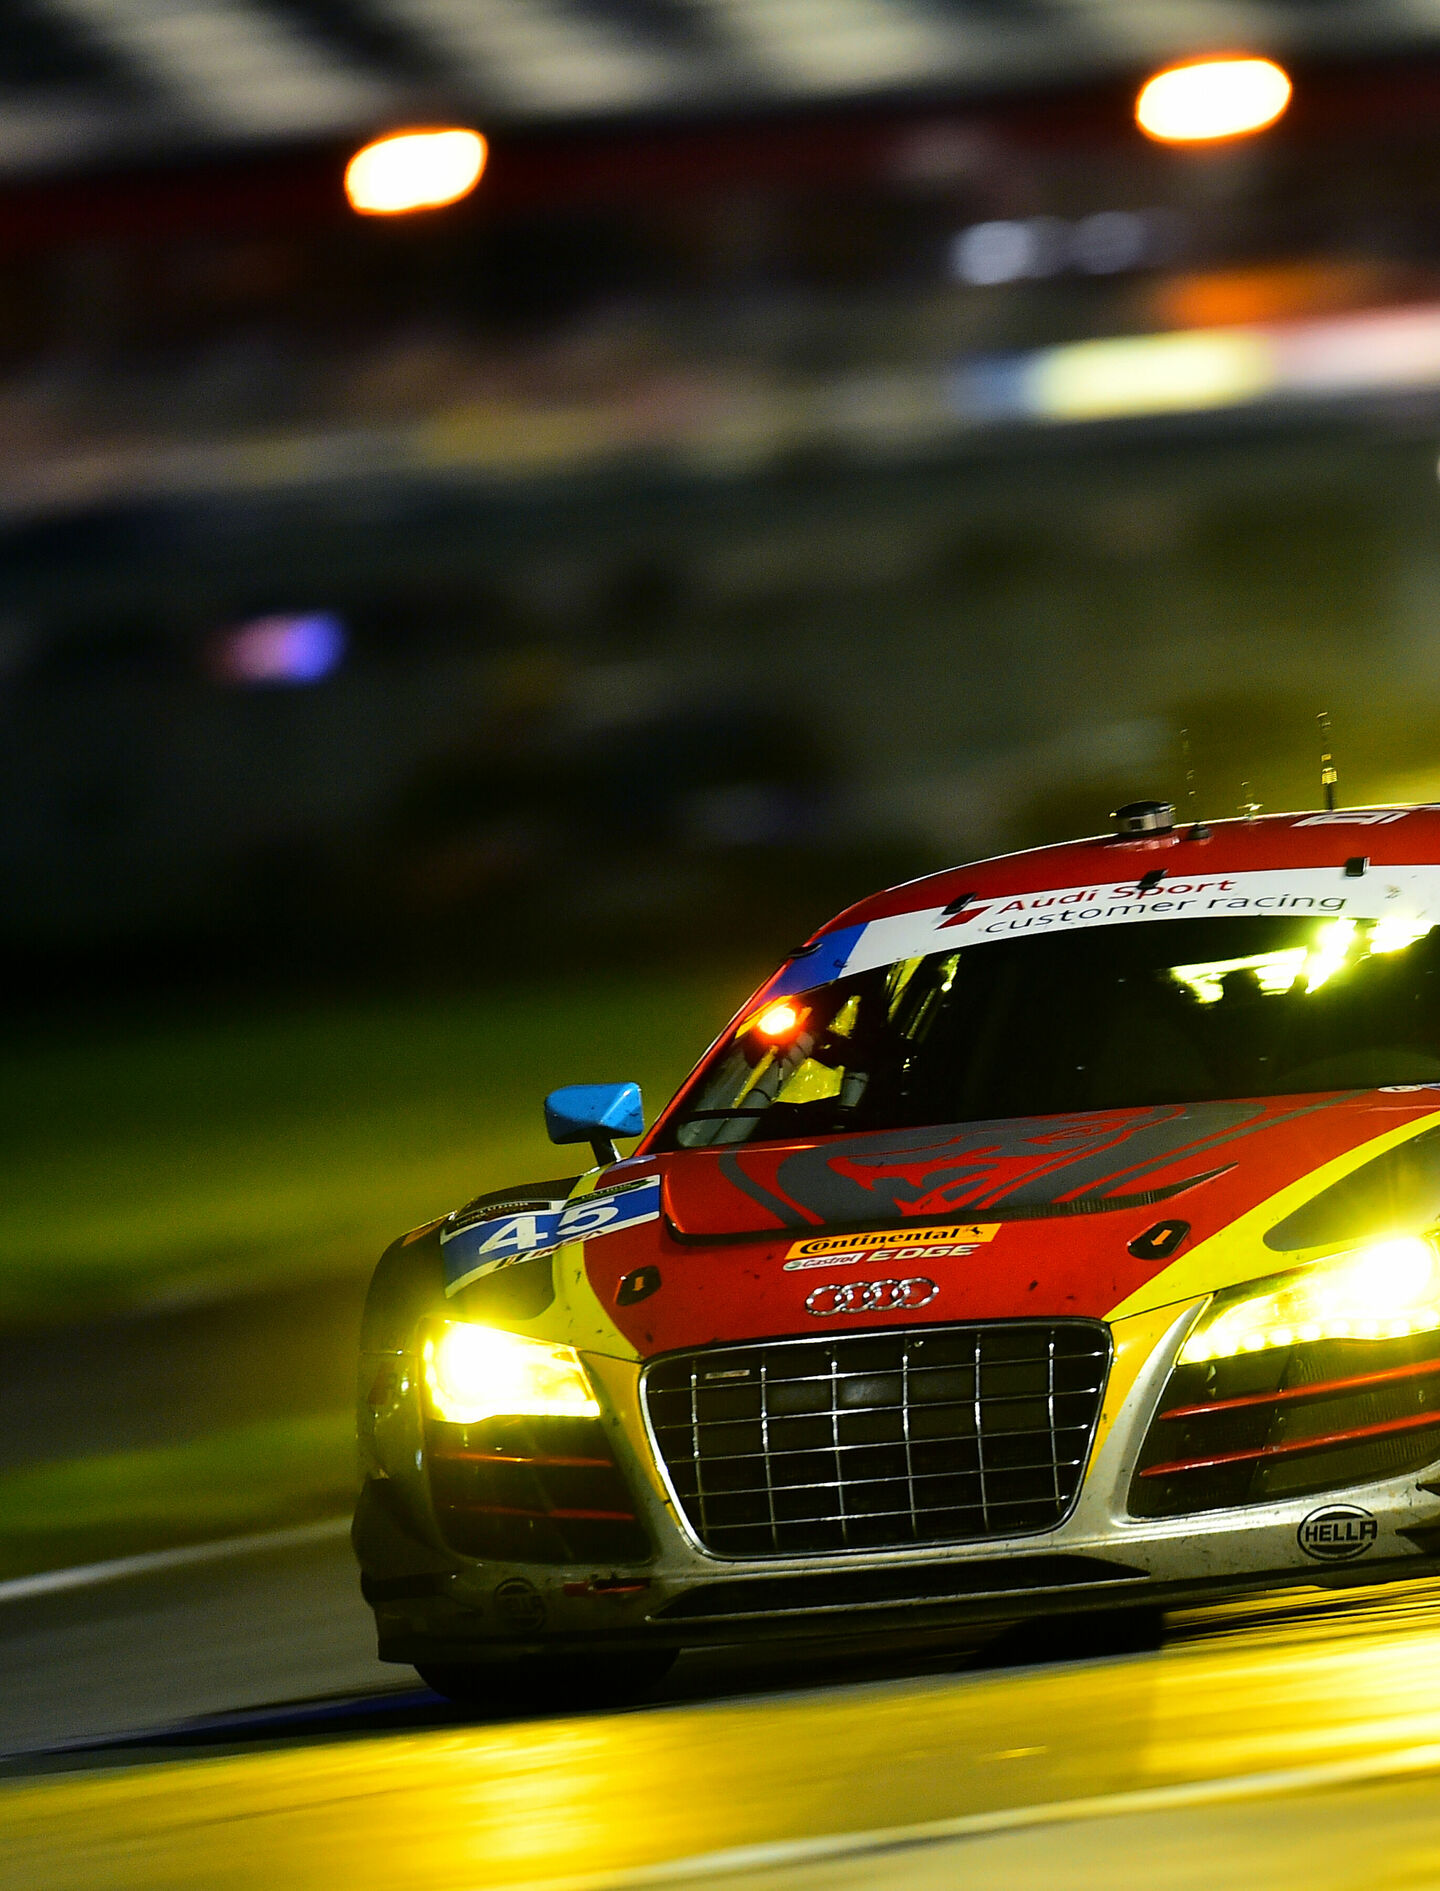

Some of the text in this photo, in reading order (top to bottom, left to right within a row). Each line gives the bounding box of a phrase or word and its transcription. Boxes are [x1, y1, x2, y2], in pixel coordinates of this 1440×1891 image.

[996, 878, 1237, 914] Audi Sport
[984, 893, 1348, 933] customer racing
[478, 1197, 620, 1254] 45
[799, 1227, 960, 1254] Continental
[802, 1244, 981, 1268] Castrol EDGE
[1304, 1519, 1378, 1543] HELLA
